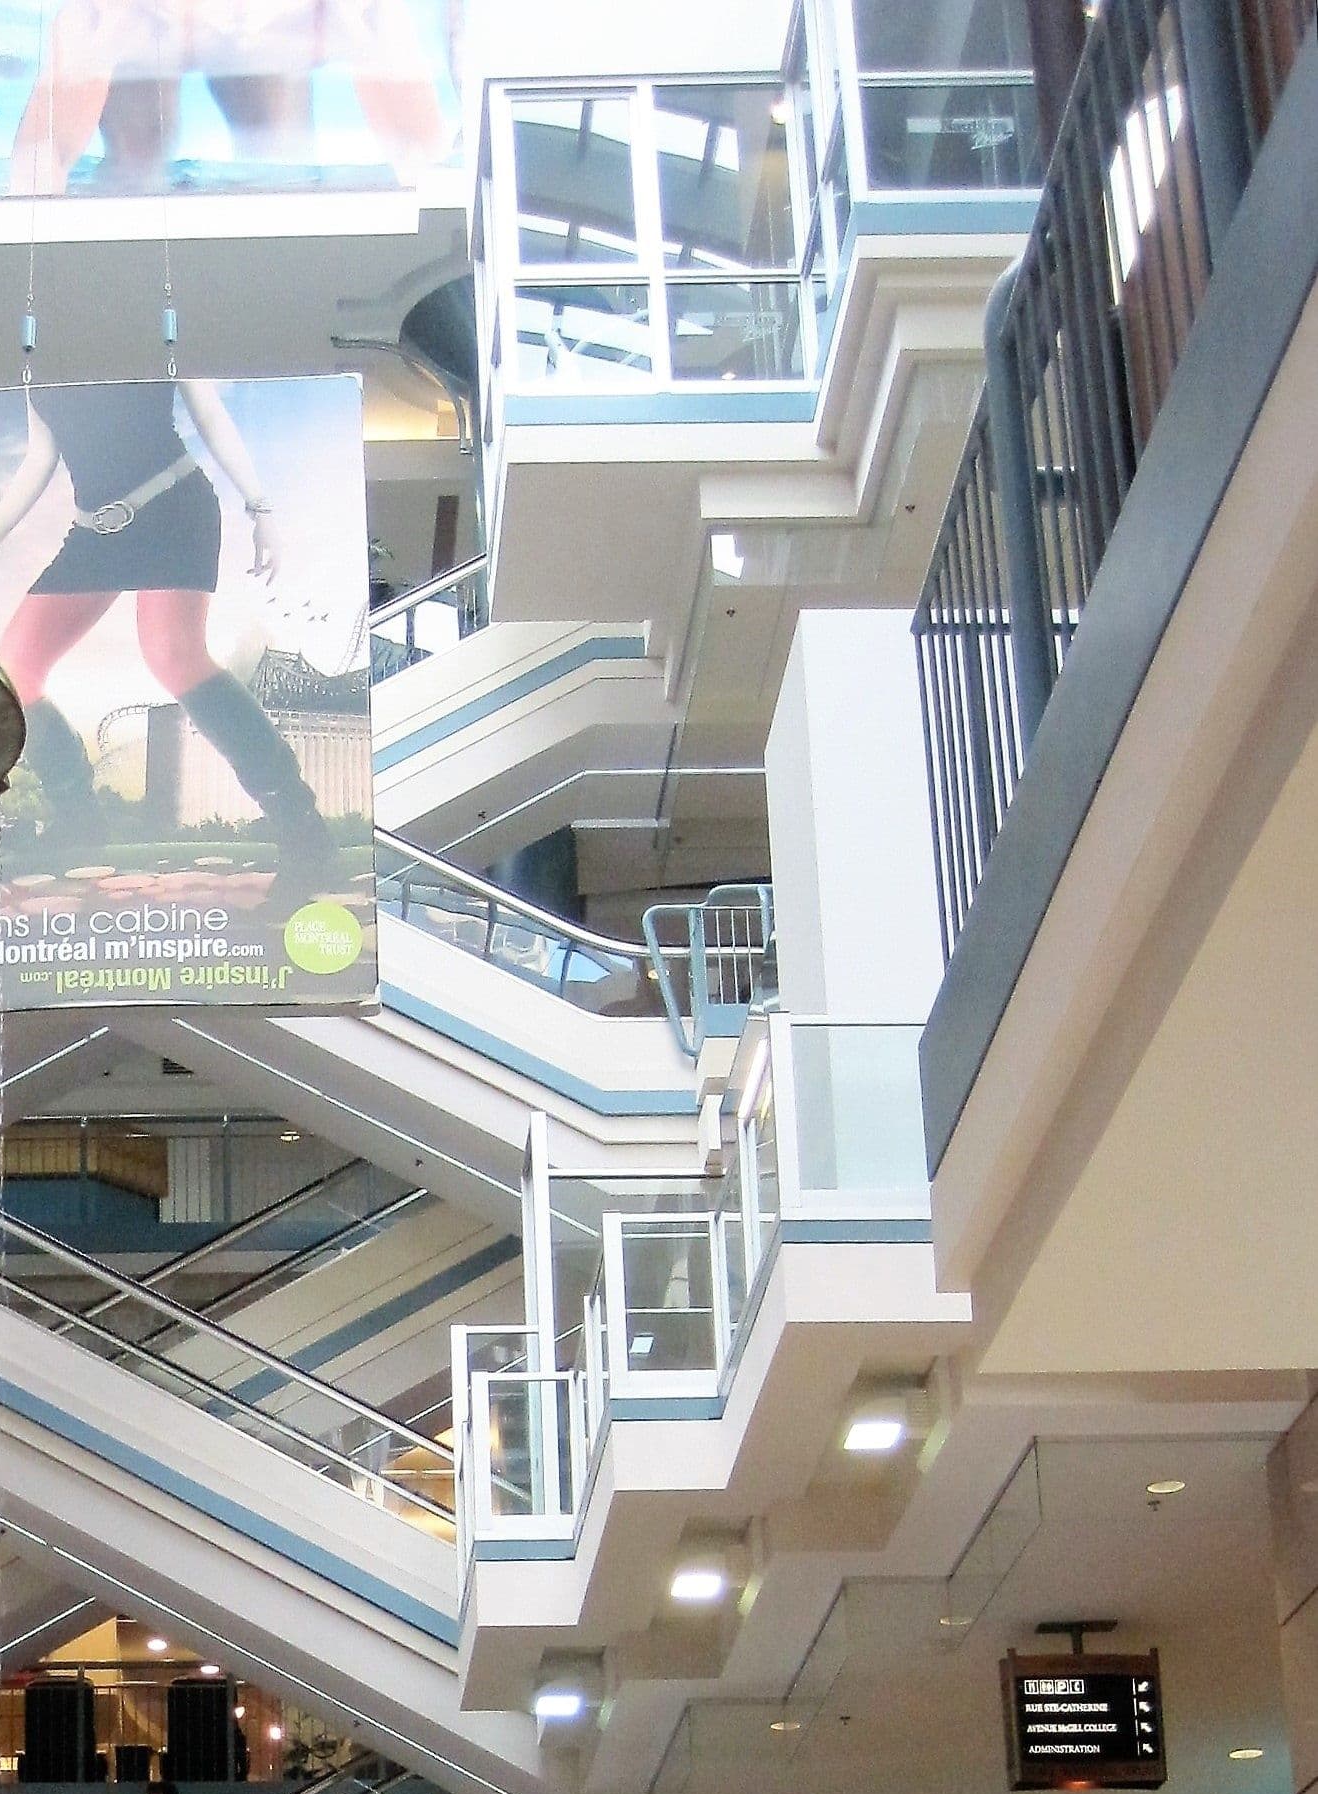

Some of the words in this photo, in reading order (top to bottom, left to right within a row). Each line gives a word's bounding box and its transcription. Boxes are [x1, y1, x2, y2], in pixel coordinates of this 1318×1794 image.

[43, 907, 76, 936] la
[89, 902, 229, 934] cabine
[1029, 1744, 1100, 1753] ADMINISTRATION
